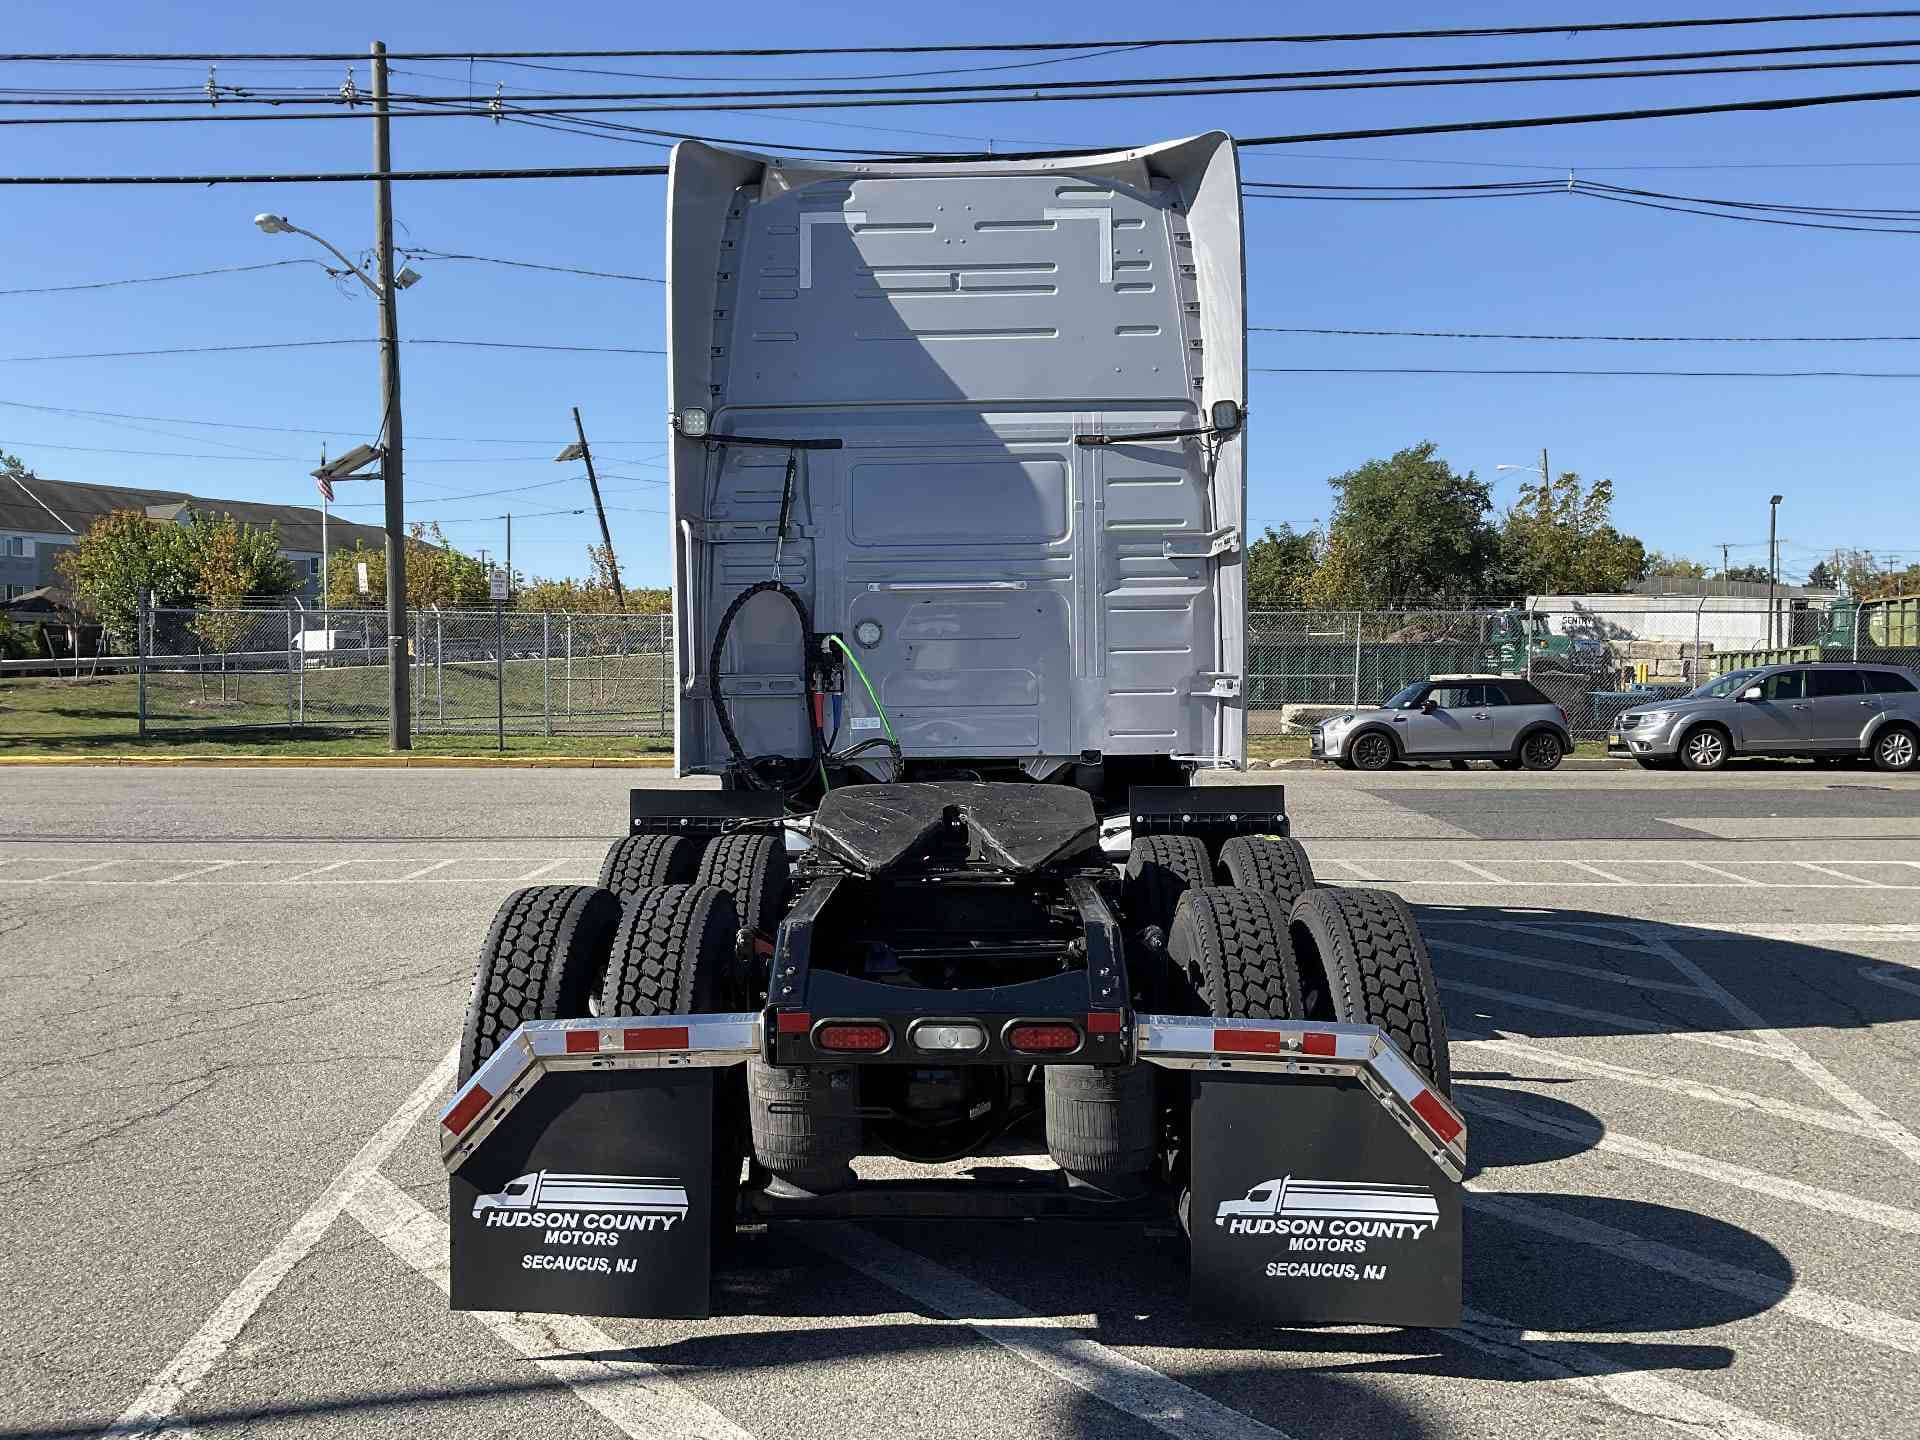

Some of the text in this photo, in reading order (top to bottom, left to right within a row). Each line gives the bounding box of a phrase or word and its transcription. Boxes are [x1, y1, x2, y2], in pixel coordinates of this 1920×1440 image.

[1562, 616, 1593, 625] SENTRY
[486, 1211, 678, 1231] HUDSON COUNTY
[1229, 1218, 1428, 1240] HUDSON COUNTY
[543, 1230, 620, 1246] MOTORS
[1288, 1237, 1367, 1253] MOTORS
[521, 1254, 638, 1274] SECAUCUS, NJ
[1265, 1262, 1387, 1281] SECAUCUS, NJ
